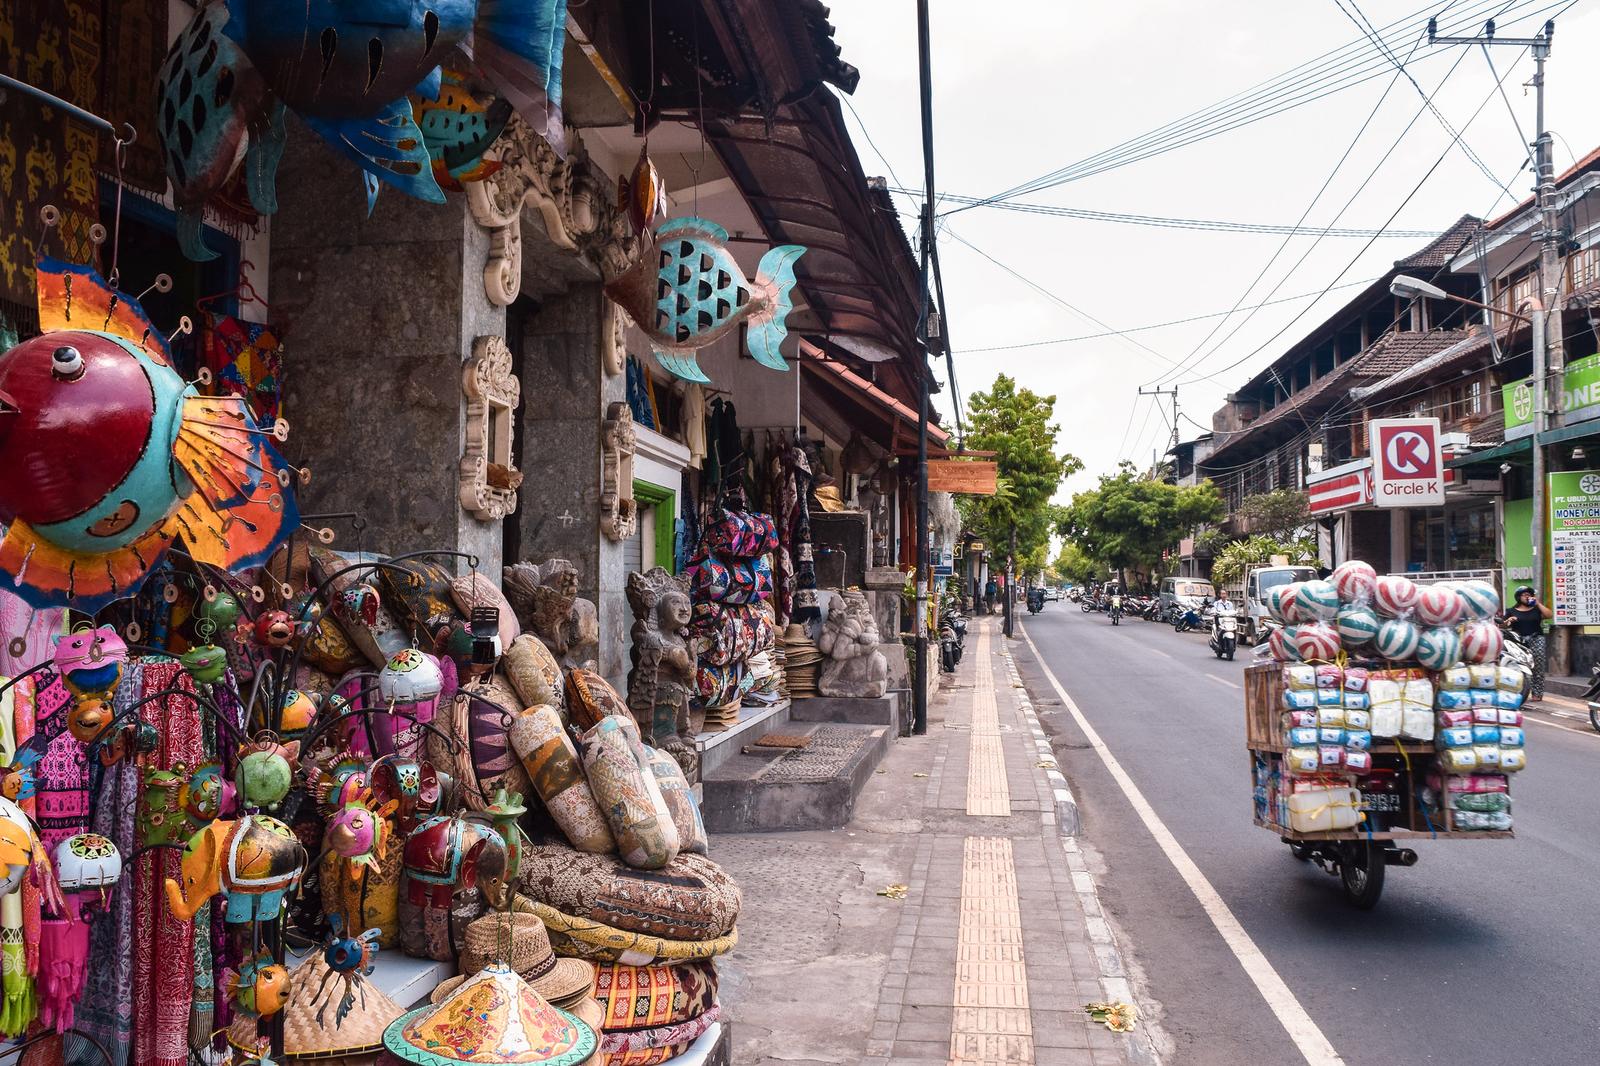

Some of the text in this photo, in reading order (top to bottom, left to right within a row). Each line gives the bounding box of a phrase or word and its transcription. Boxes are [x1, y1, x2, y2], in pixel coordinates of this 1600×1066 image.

[1384, 482, 1438, 495] Circle K
[1556, 510, 1585, 518] MONEY
